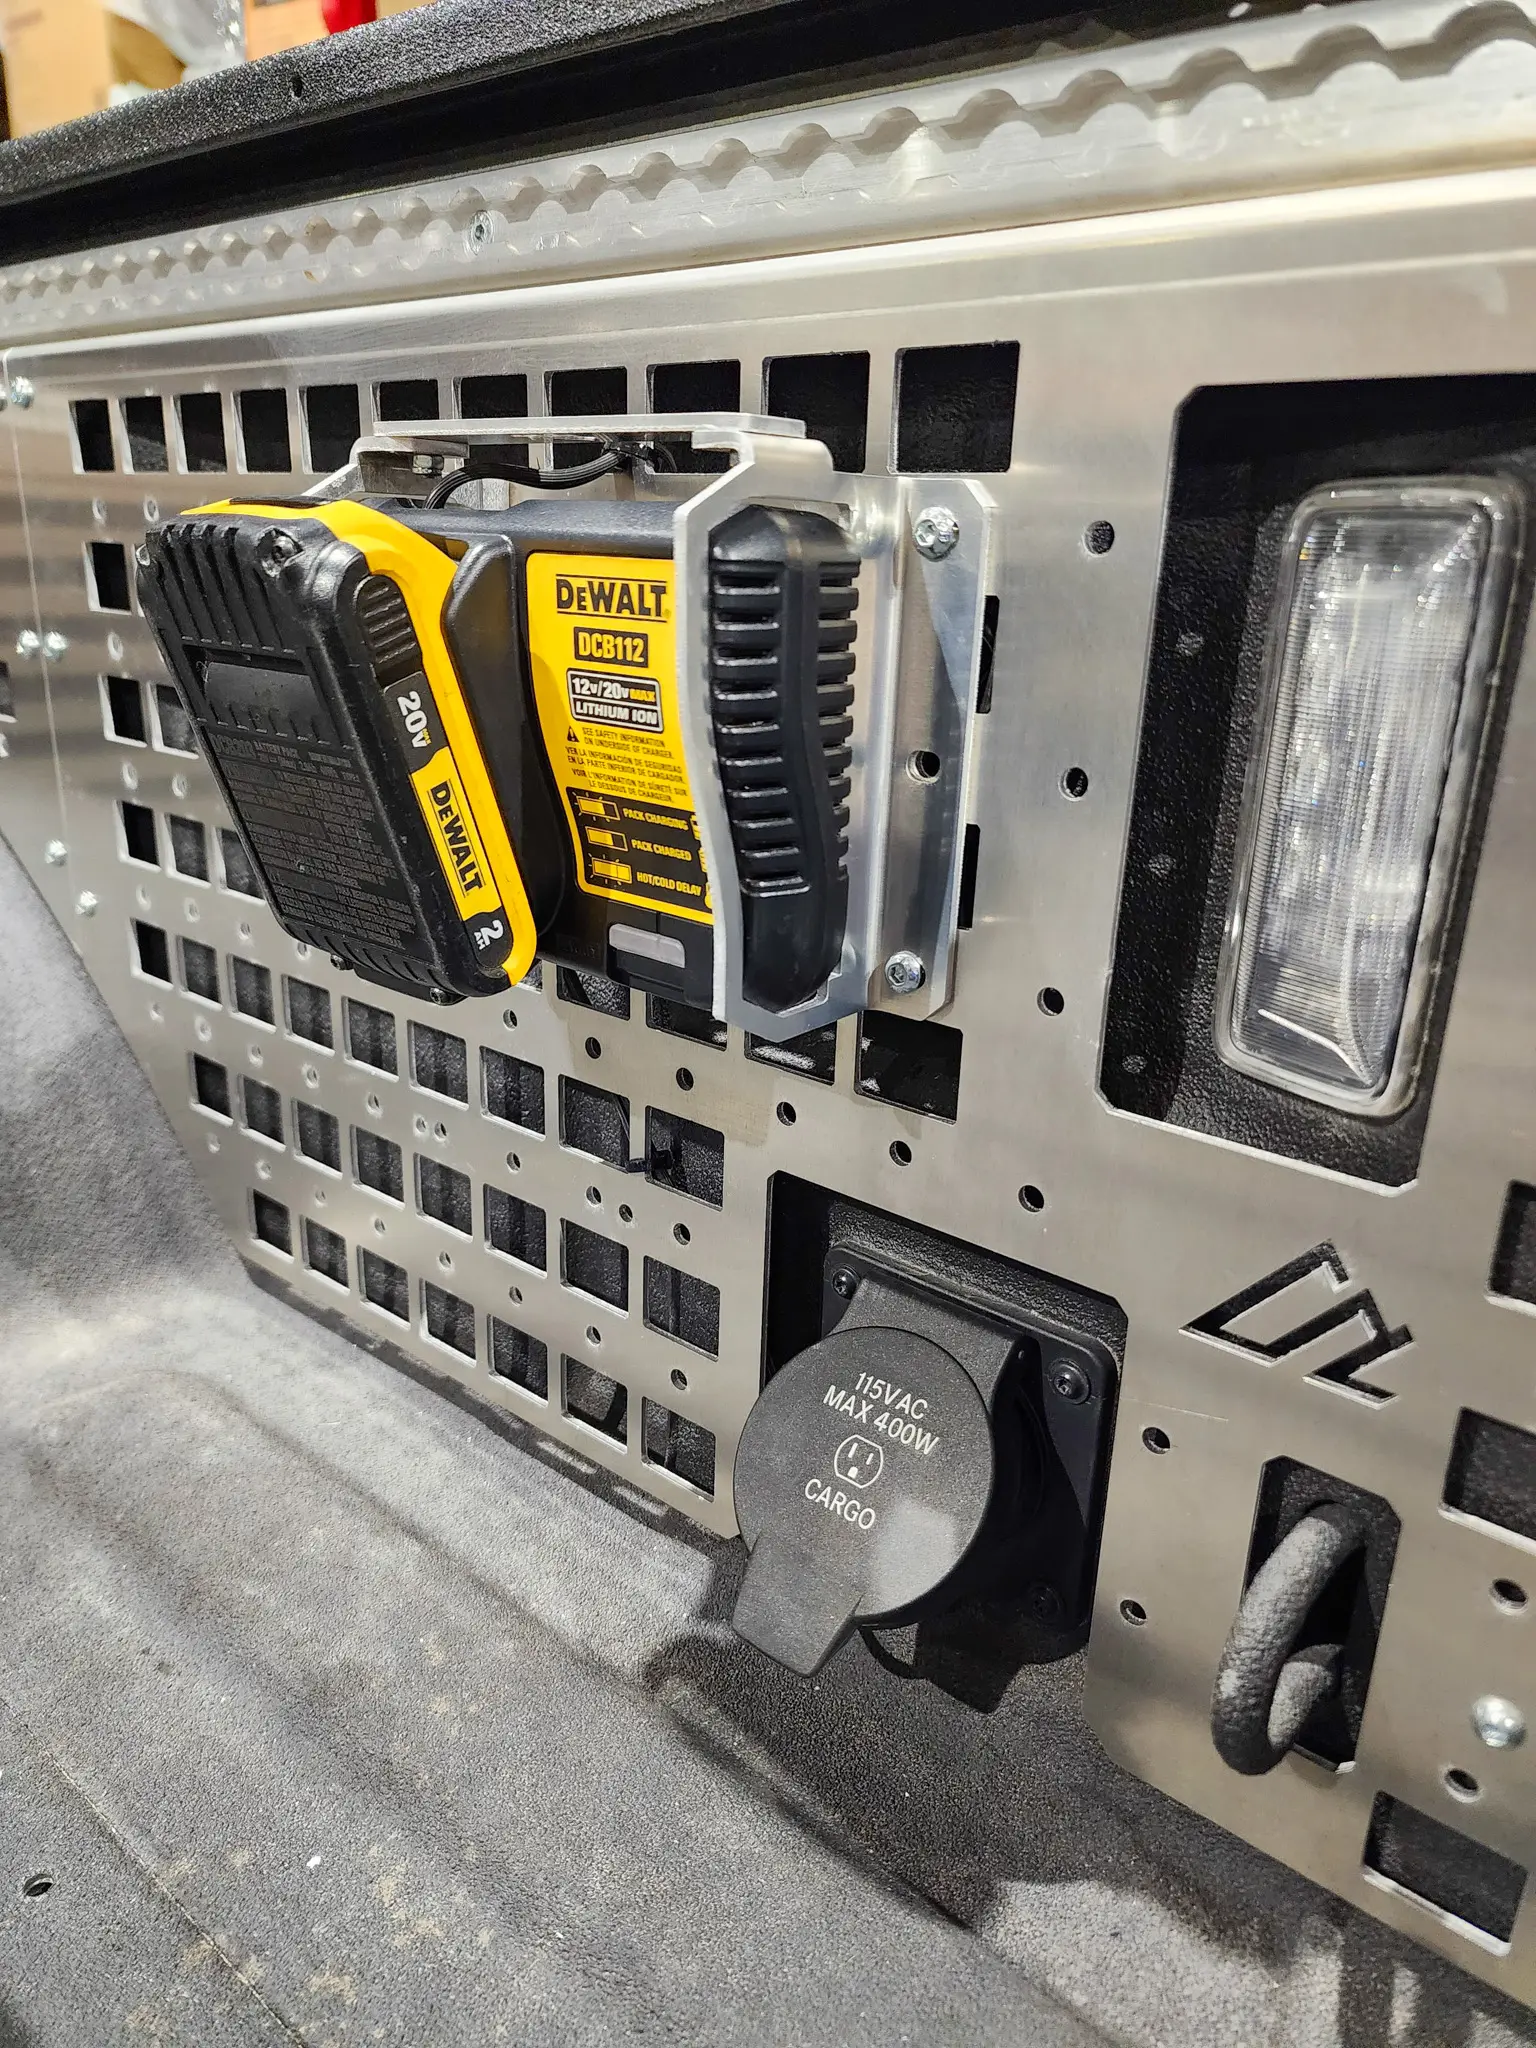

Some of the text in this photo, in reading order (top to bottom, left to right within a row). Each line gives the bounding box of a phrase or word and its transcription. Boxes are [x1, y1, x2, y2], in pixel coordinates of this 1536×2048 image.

[578, 632, 644, 663] DCB112
[630, 688, 656, 702] MAX
[397, 690, 427, 749] 20V
[576, 702, 658, 724] LITHIUM ION
[582, 727, 666, 747] SEE SAFETY INFORMATION
[584, 737, 593, 745] ON
[596, 739, 632, 751] UNDERSIDE
[566, 746, 578, 755] VER
[579, 748, 587, 757] LA
[635, 757, 643, 766] DE
[568, 756, 577, 764] EN
[577, 757, 585, 765] LA
[587, 759, 606, 769] PARTE
[608, 762, 636, 774] INFERIOR
[572, 768, 587, 777] VOIR
[638, 779, 647, 788] DE
[623, 808, 689, 831] PACK CHARGING
[631, 839, 692, 862] PACK CHARGED
[636, 872, 702, 896] HOT/COLD DELAY
[482, 919, 505, 945] 2
[854, 1371, 929, 1420] 115VAC
[823, 1384, 939, 1456] MAX 400W
[804, 1478, 877, 1531] CARGO
